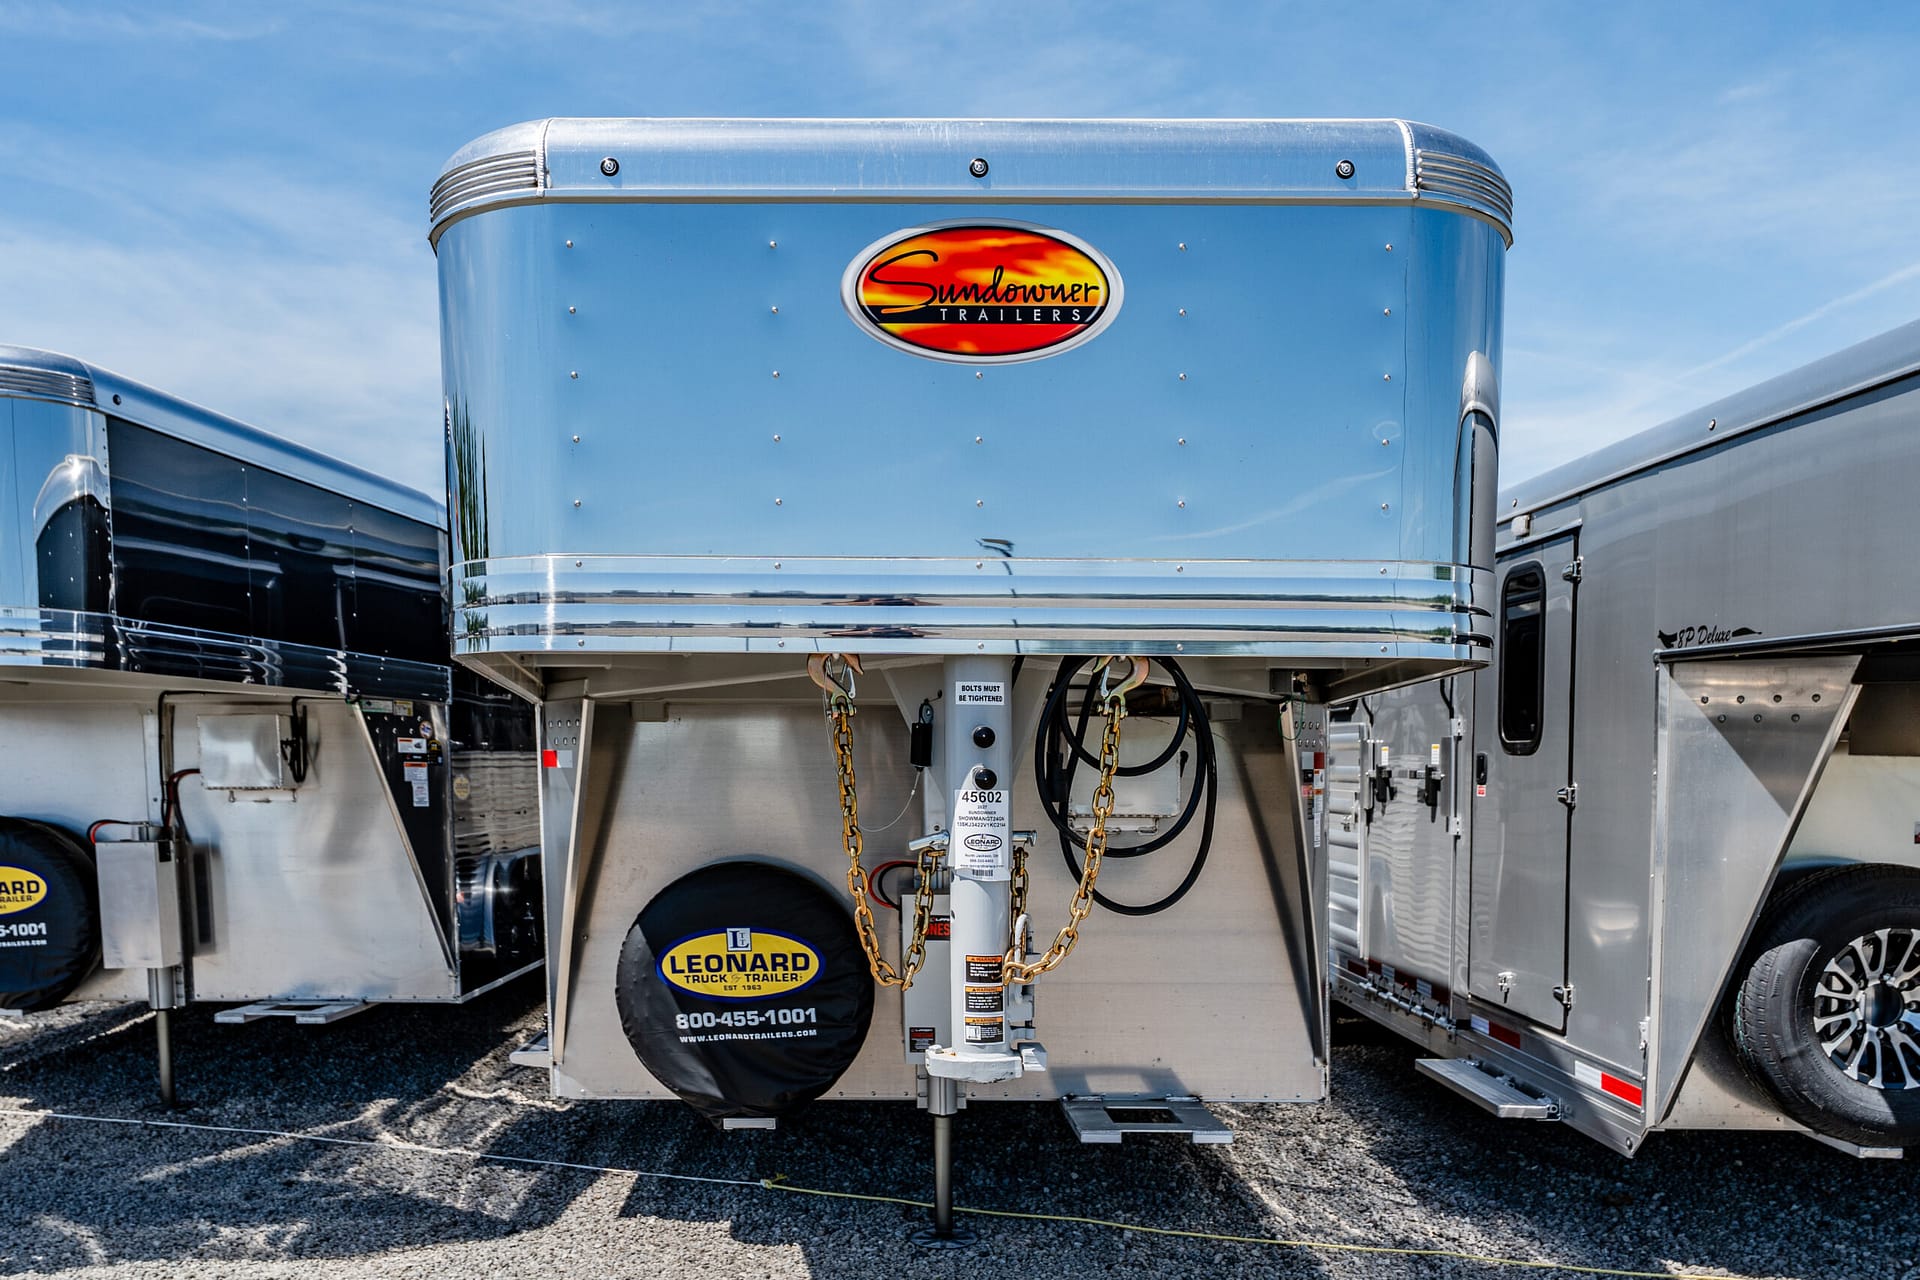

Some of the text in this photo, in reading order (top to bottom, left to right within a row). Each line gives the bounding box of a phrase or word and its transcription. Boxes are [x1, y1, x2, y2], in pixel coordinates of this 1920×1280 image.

[869, 249, 1100, 313] Sundowner
[940, 308, 1081, 321] TRAILERS
[1698, 624, 1732, 645] Deluxe
[961, 791, 1003, 803] 45602
[670, 952, 810, 974] LEONARD
[684, 974, 728, 984] TRUCK
[744, 973, 799, 983] TRAILER
[675, 1007, 817, 1030] 800-455-1001
[679, 1029, 817, 1043] WWW.LEONARDTRAILERS.COM
